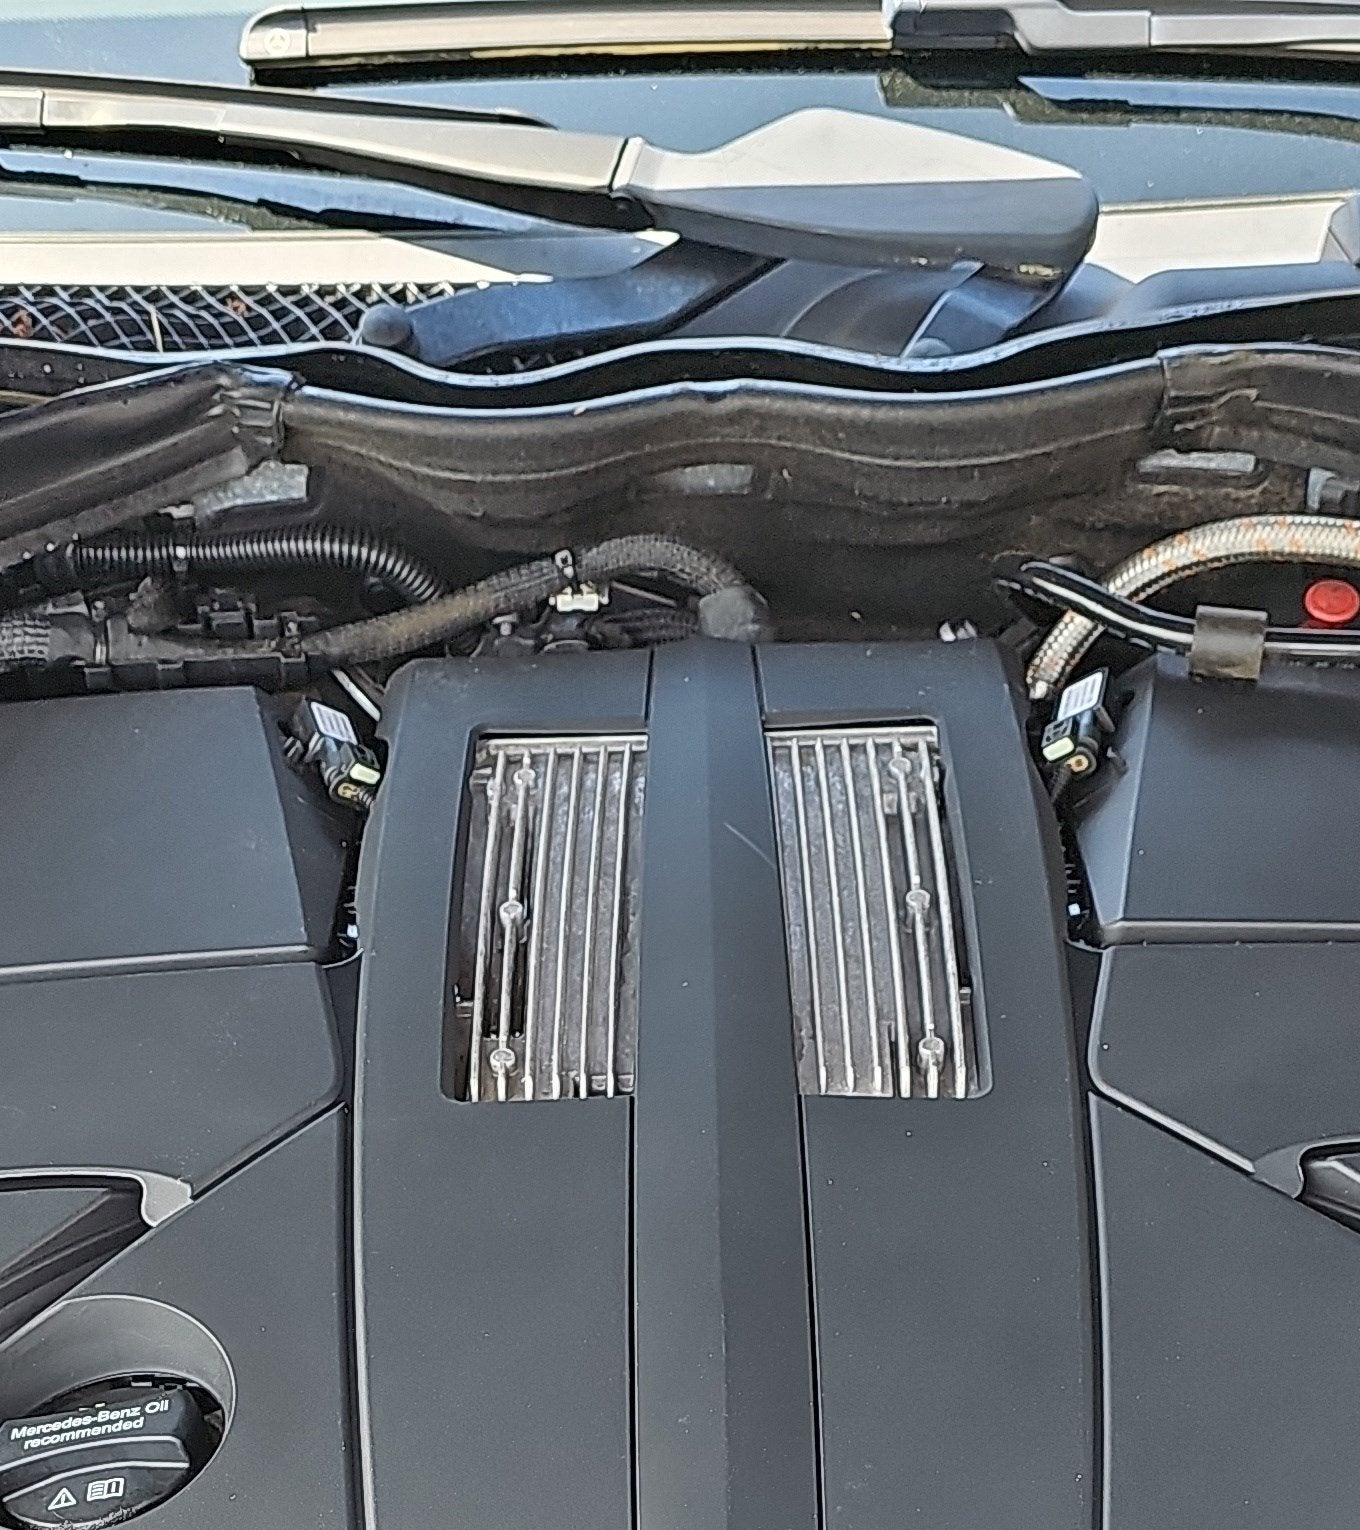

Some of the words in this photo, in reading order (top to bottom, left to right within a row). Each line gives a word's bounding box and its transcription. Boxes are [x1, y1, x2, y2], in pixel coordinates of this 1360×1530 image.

[11, 1405, 141, 1441] Mercedes-Benz
[144, 1399, 170, 1415] Oil
[23, 1416, 145, 1450] recommended
